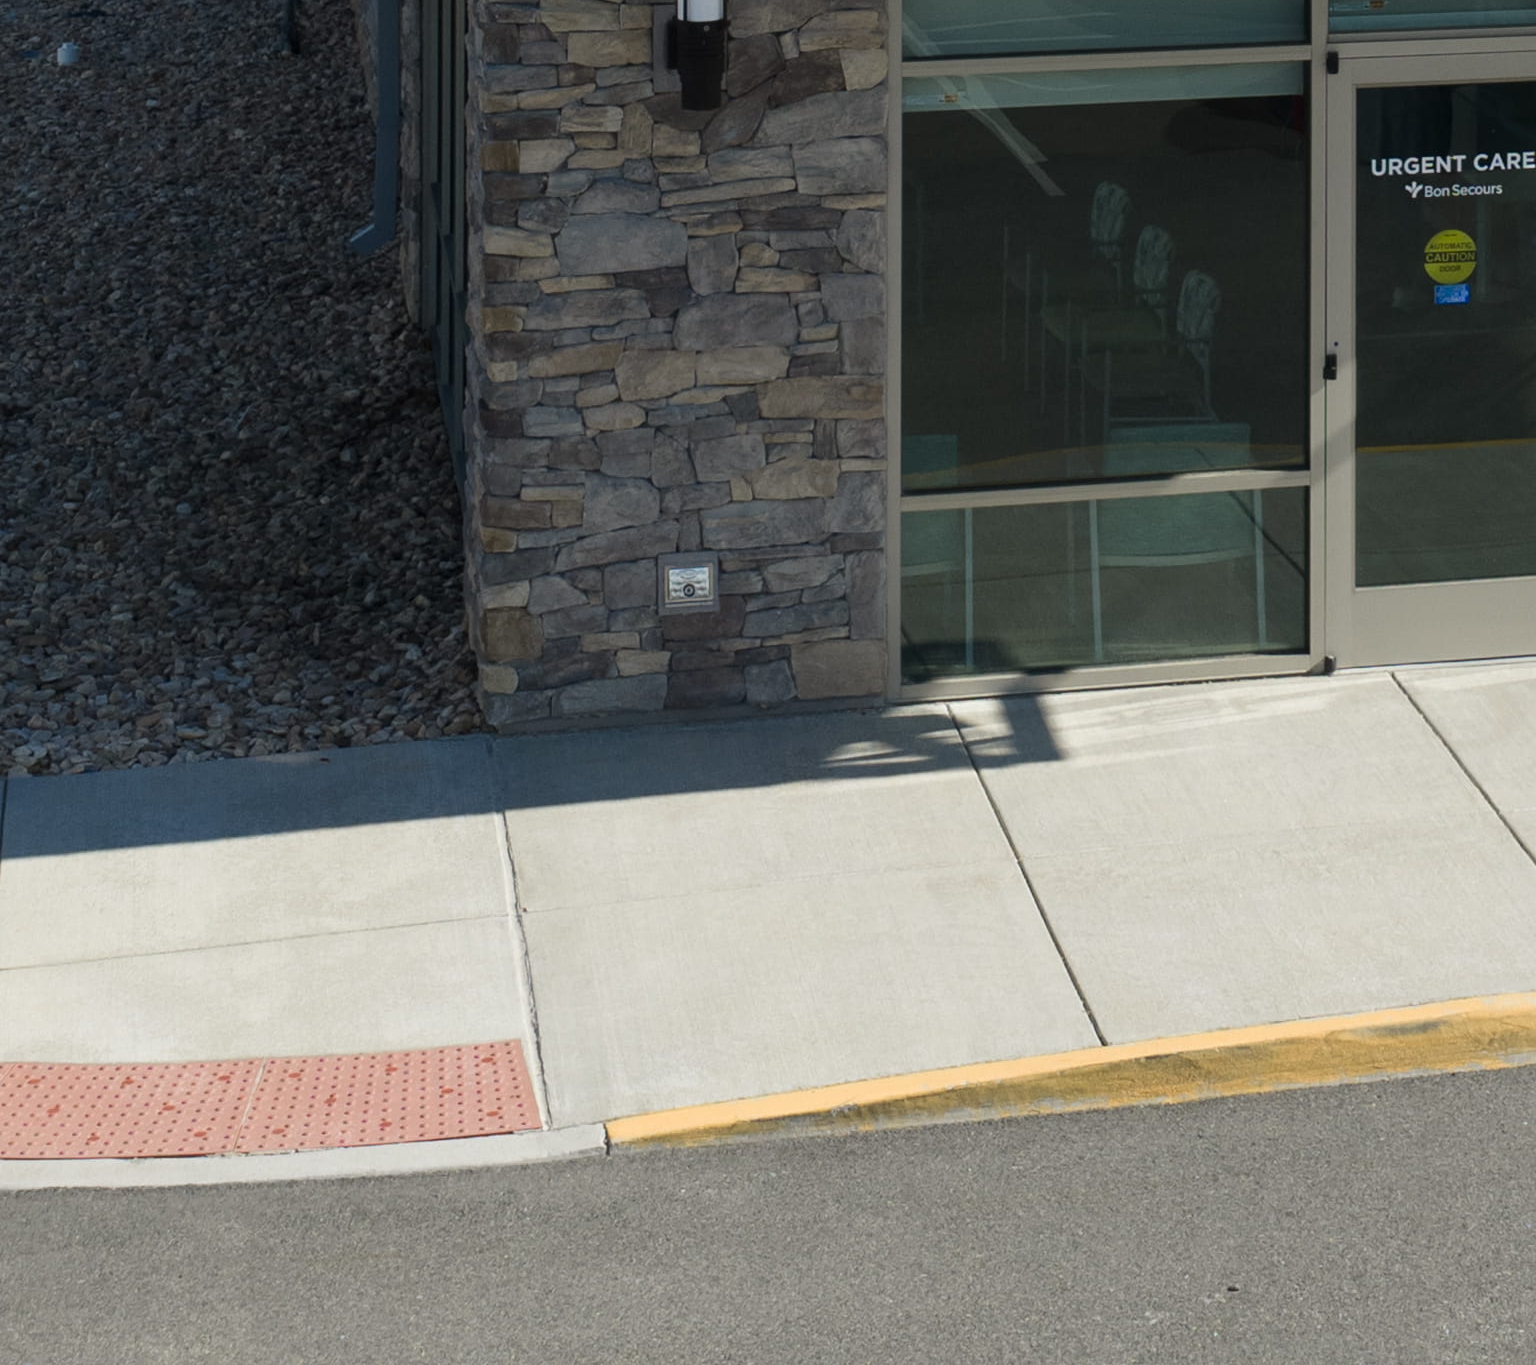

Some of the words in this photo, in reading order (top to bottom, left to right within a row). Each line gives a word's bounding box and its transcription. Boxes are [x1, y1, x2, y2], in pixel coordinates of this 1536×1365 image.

[1371, 155, 1467, 176] URGENT
[1473, 151, 1536, 171] CARE
[1424, 185, 1451, 198] Bon
[1452, 183, 1503, 197] Secours
[1426, 252, 1475, 263] CAUTION
